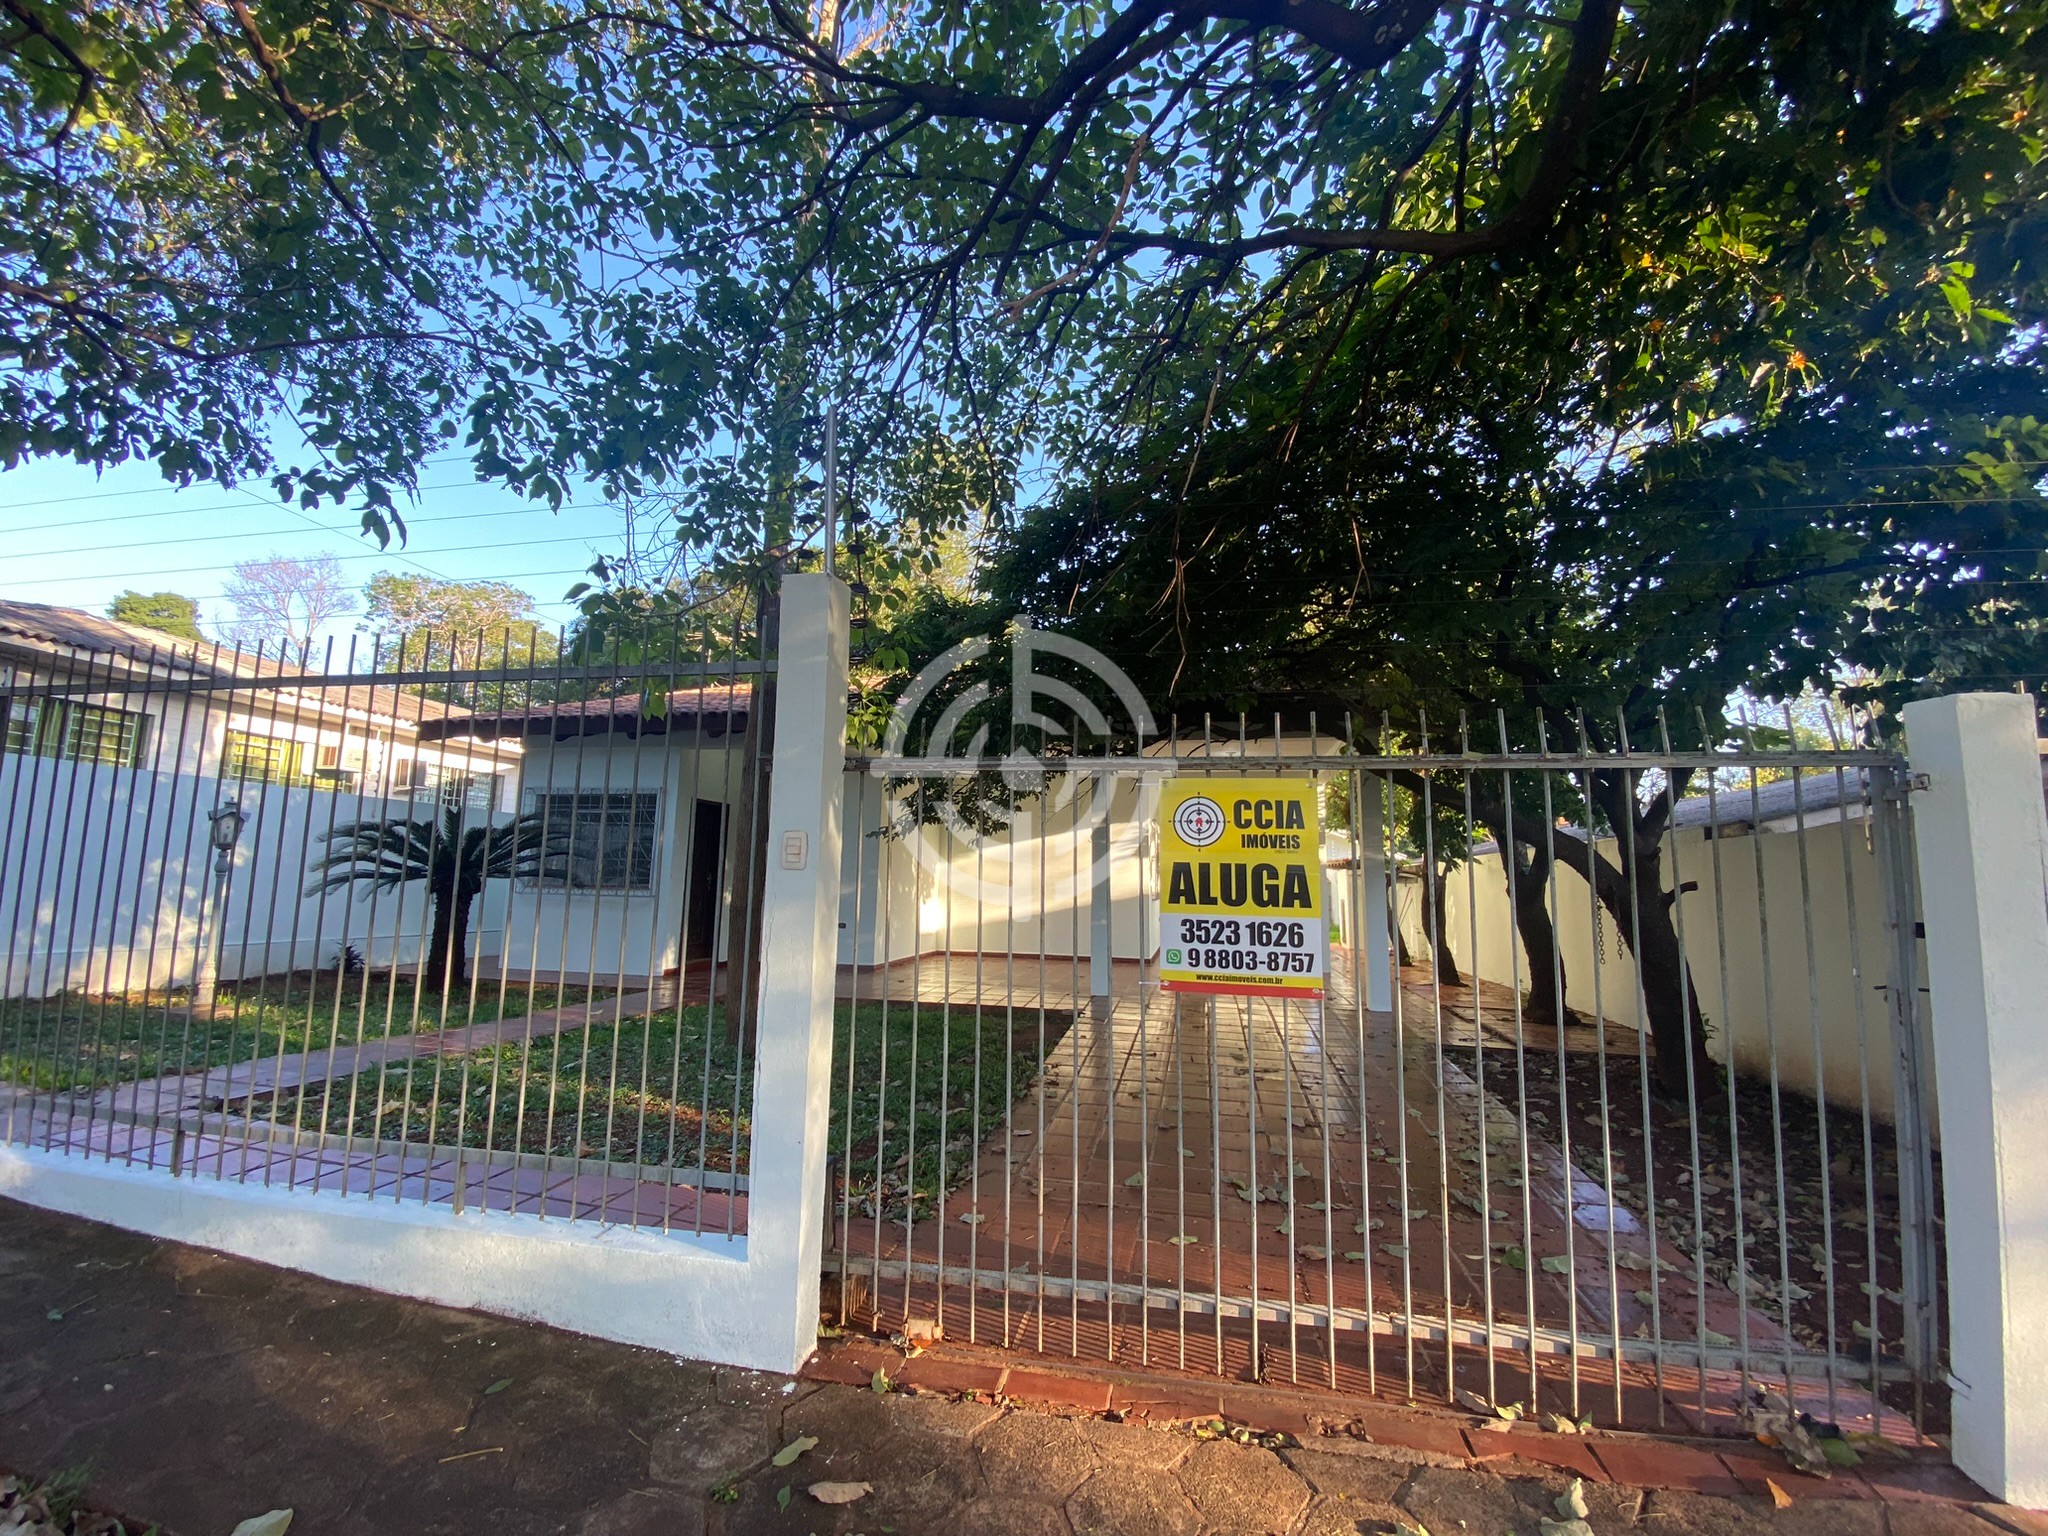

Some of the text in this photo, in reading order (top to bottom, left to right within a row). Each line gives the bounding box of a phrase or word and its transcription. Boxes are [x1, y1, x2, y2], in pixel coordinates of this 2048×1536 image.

[1233, 799, 1305, 830] CCIA
[1241, 832, 1301, 850] IMÓVEIS
[1168, 861, 1312, 909] ALUGA
[1180, 918, 1304, 948] 3523 1626
[1187, 948, 1315, 973] 9 8803-8757
[1196, 973, 1283, 985] www.cciaimoveis.com.br
